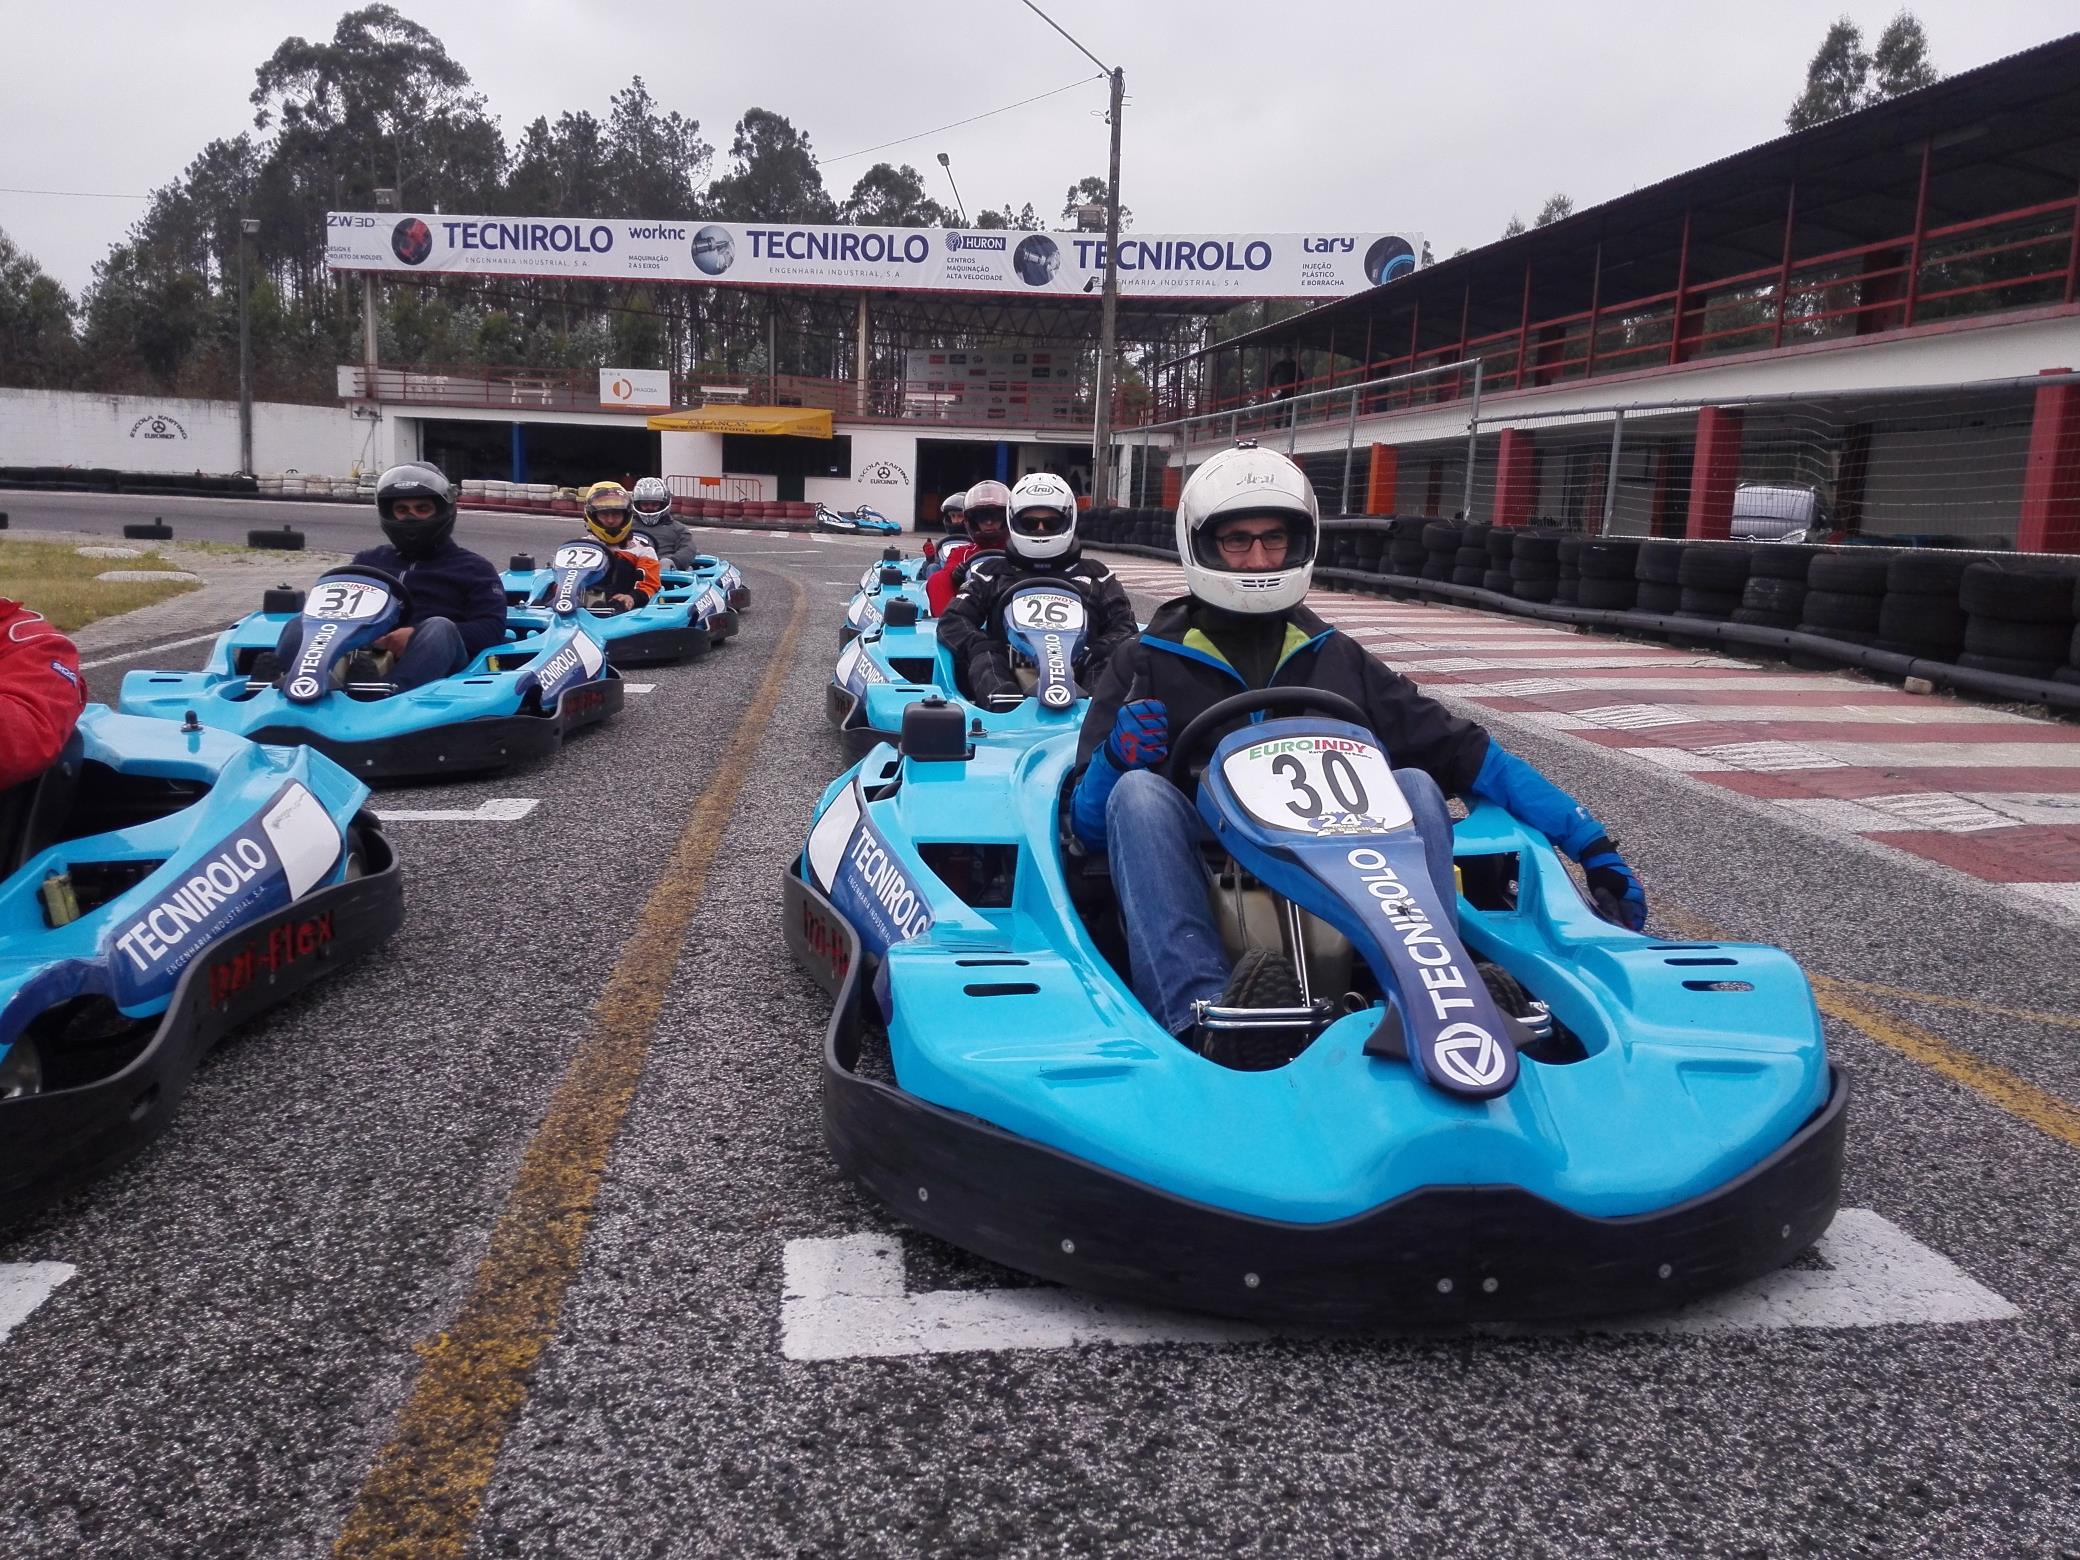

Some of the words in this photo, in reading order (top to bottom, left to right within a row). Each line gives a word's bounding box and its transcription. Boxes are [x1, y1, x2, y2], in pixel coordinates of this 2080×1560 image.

[442, 222, 614, 254] TECNIROLO
[628, 223, 686, 241] worknc
[746, 230, 930, 264] TECNIROLO
[966, 236, 1004, 249] HURON
[465, 257, 517, 265] ENGENHARIA
[1073, 240, 1273, 271] TECNIROLO
[1302, 261, 1332, 270] INJEÇÃO
[769, 266, 824, 276] ENGENHARIA
[946, 265, 990, 273] MAQUINAÇÃO
[963, 273, 1003, 281] VELOCIDADE
[1302, 270, 1335, 278] PLÁSTICO
[1031, 484, 1051, 493] Arai
[566, 549, 597, 565] 27
[318, 588, 366, 616] 31
[1022, 595, 1074, 604] EUROINDY
[1026, 600, 1070, 624] 26
[538, 648, 578, 691] ECNIROLO
[1249, 738, 1368, 761] EUROINDY
[1271, 749, 1369, 819] 30
[847, 874, 871, 911] ENGENHARIA
[115, 838, 268, 972] TECNIROLO
[166, 932, 213, 976] ENGENHARIA
